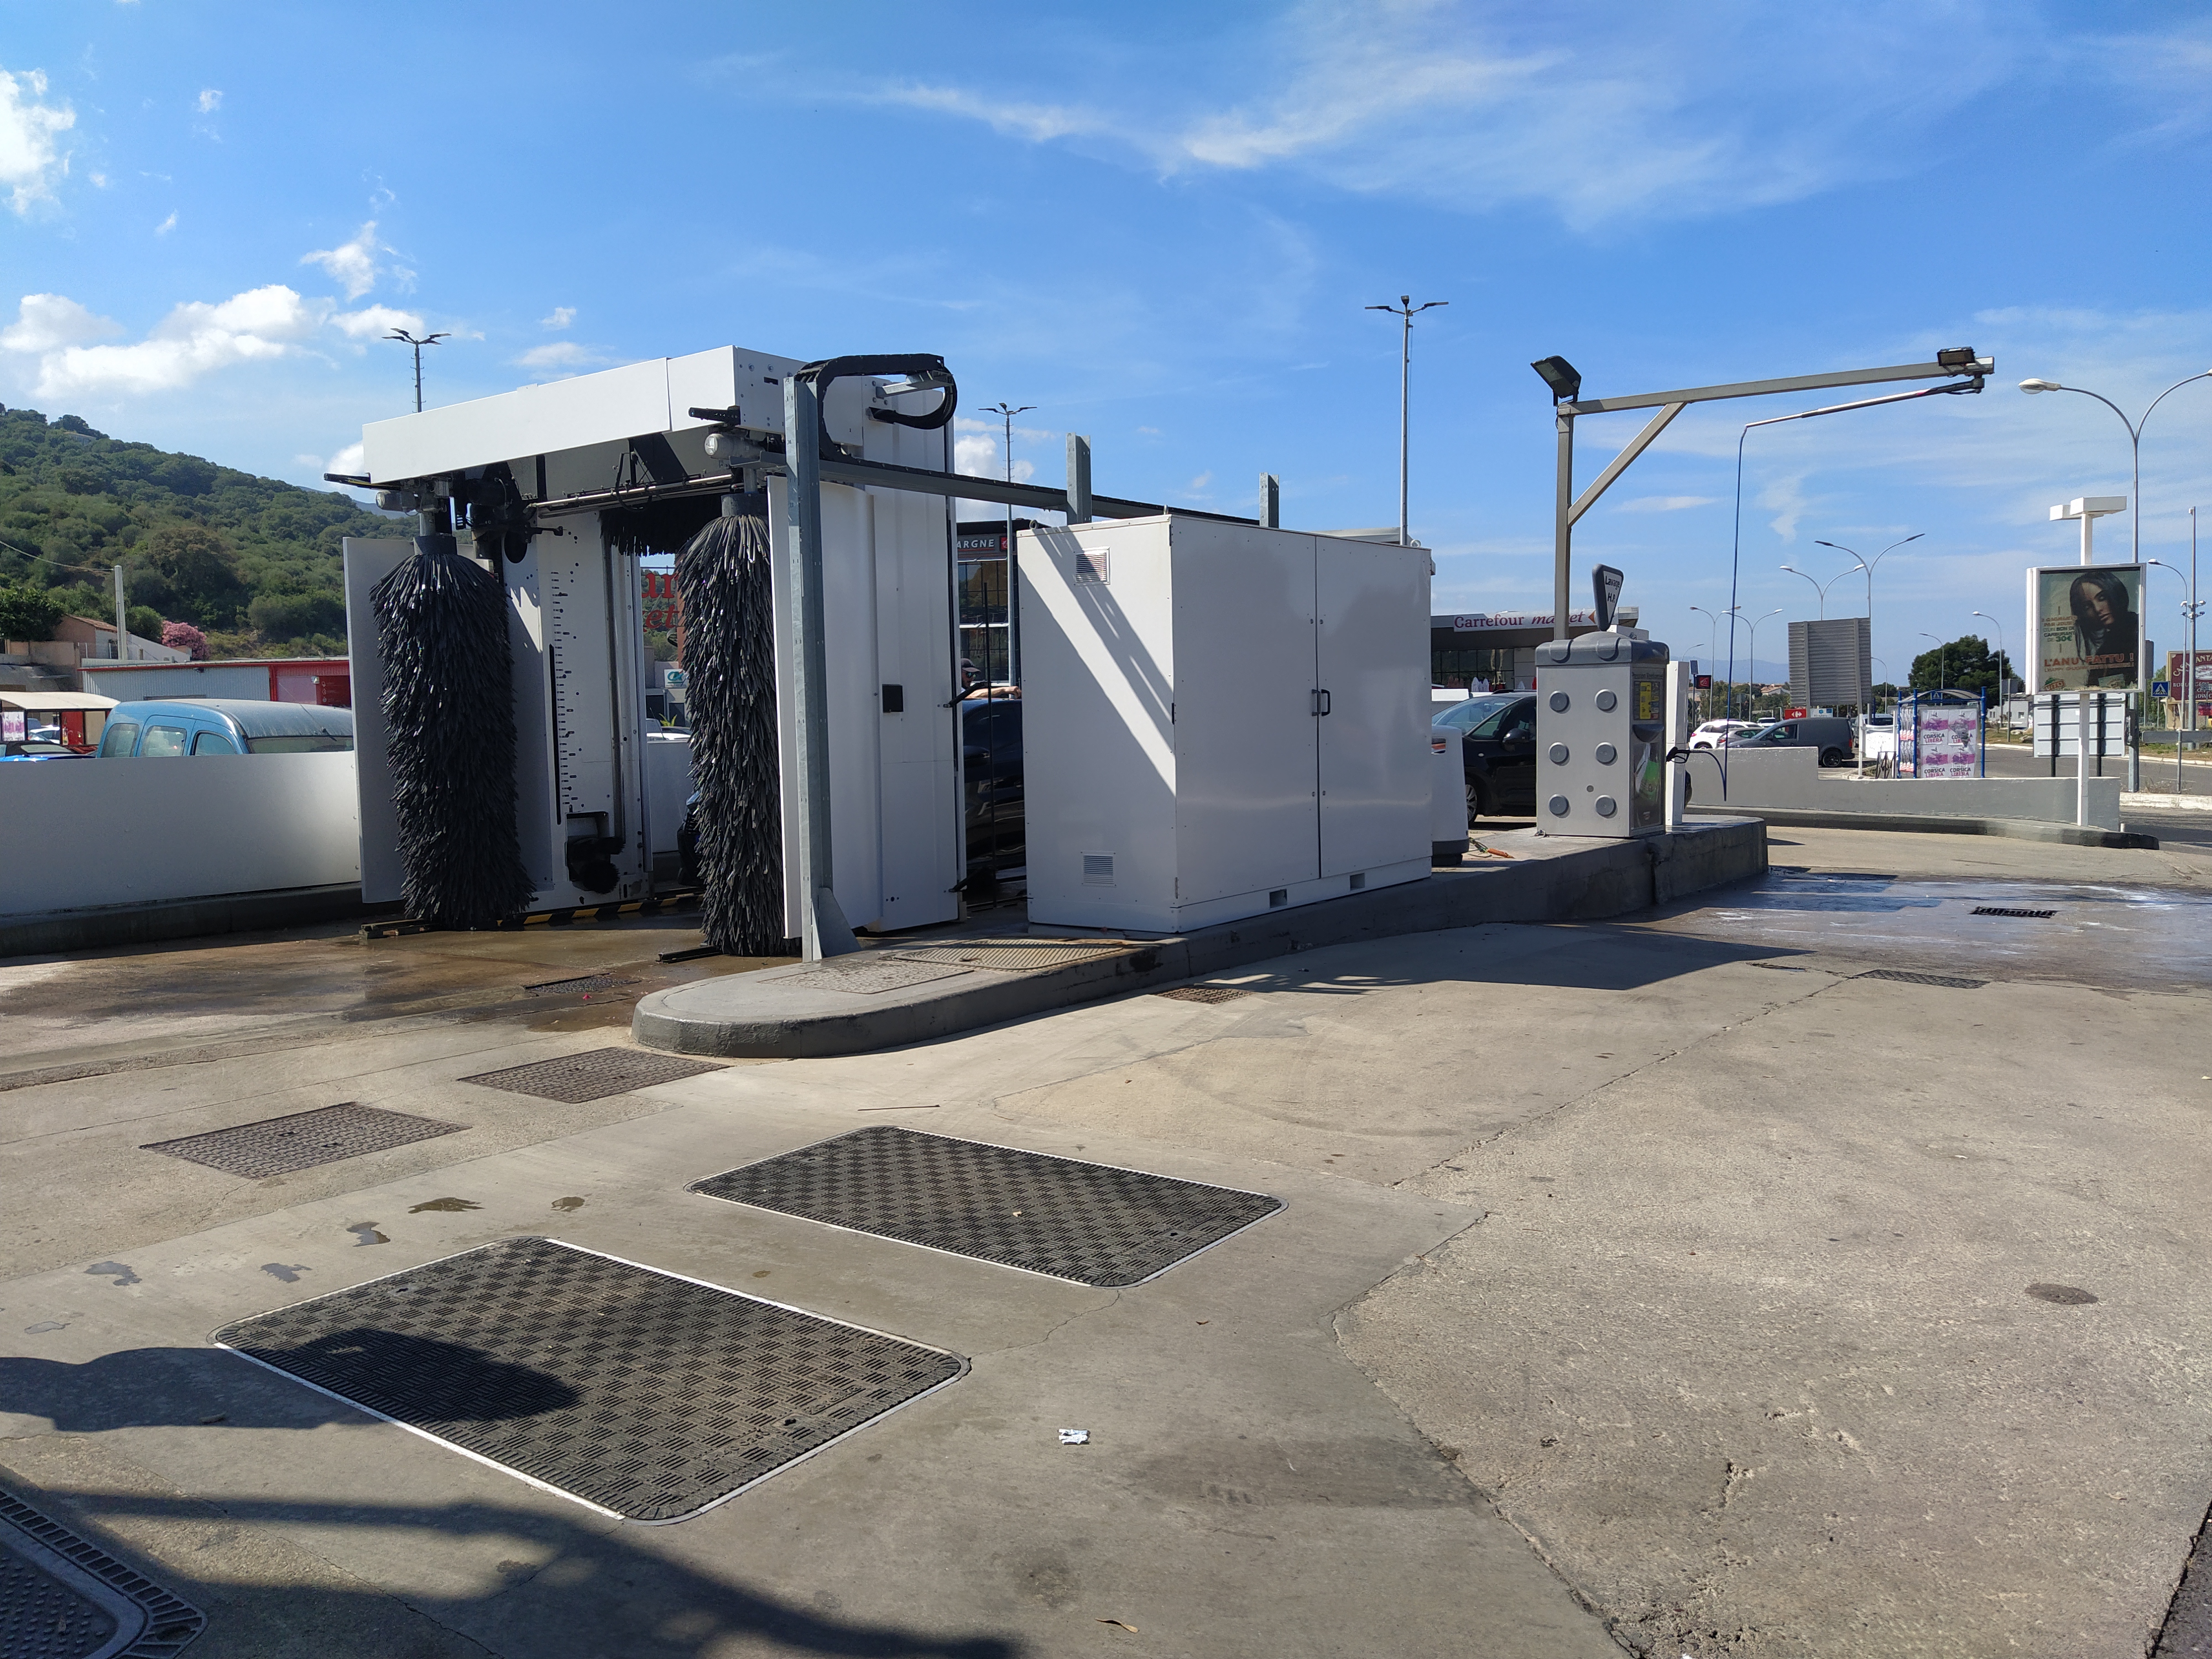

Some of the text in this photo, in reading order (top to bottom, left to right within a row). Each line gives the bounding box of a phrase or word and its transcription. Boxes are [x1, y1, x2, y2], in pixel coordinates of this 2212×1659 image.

[1605, 576, 1620, 590] Lavage
[643, 604, 680, 632] et
[1454, 611, 1585, 628] Carrefour maet
[2044, 658, 2079, 667] L'ANU
[2086, 654, 2124, 664] FATTU
